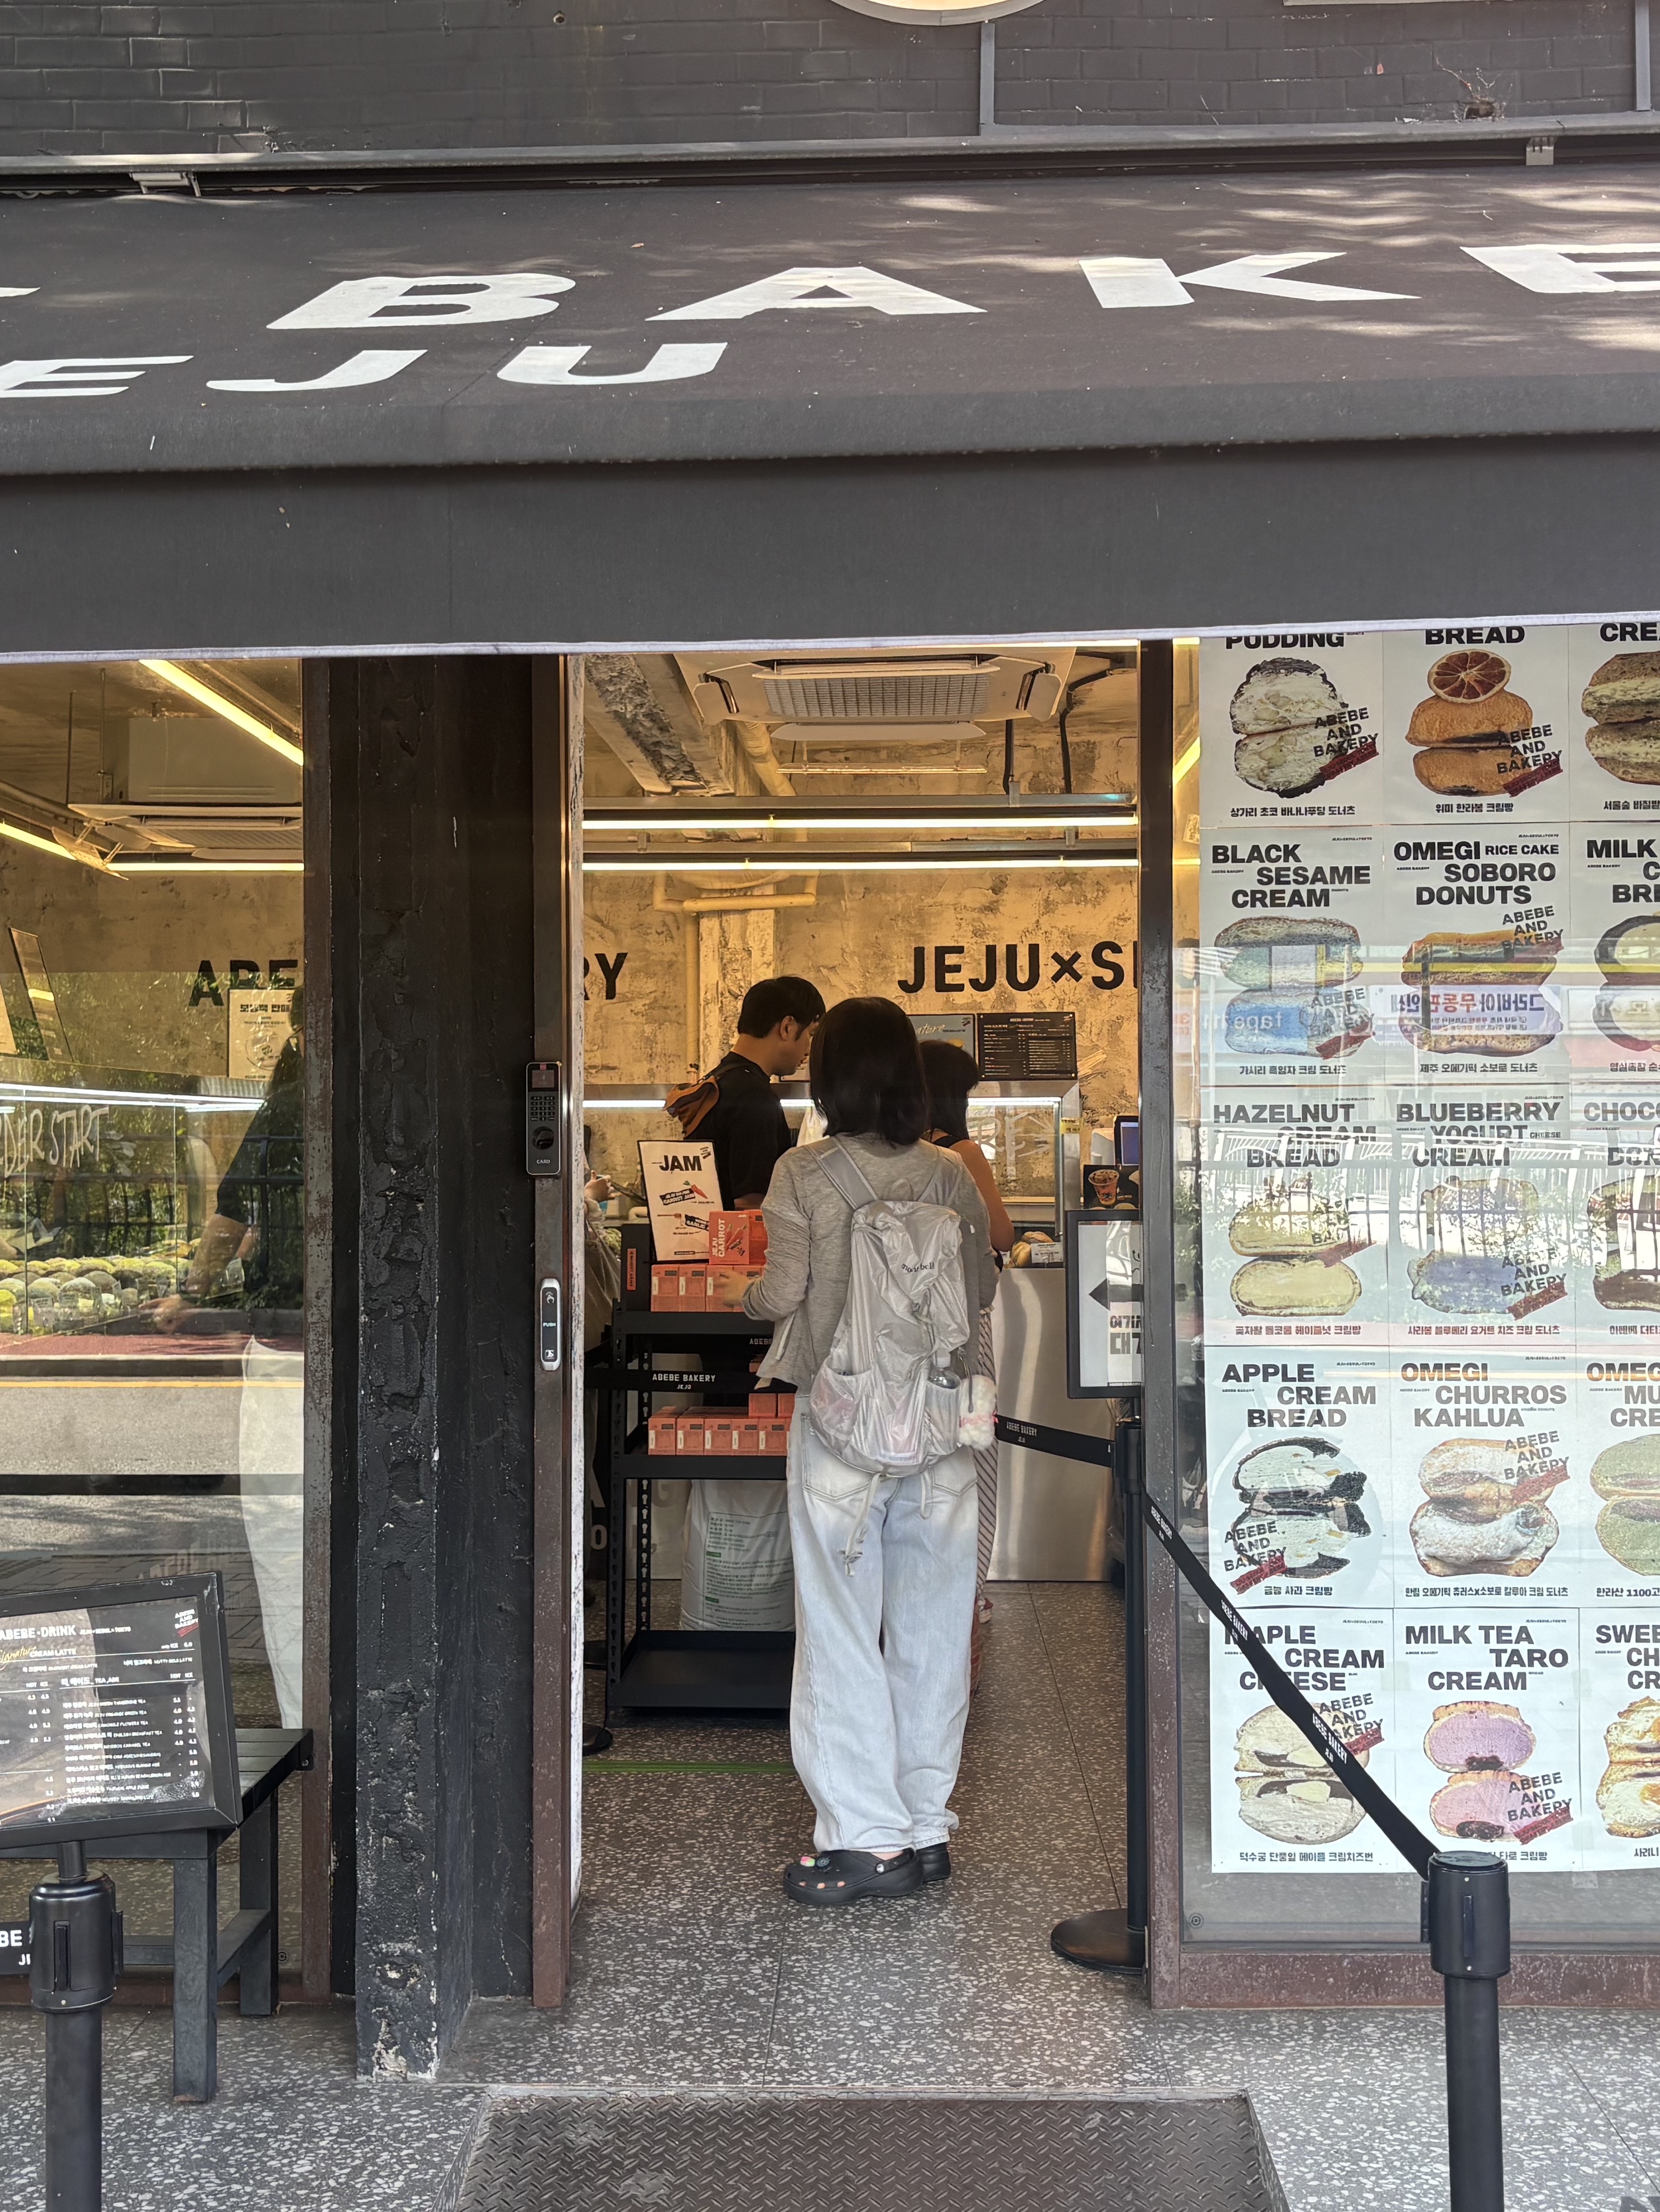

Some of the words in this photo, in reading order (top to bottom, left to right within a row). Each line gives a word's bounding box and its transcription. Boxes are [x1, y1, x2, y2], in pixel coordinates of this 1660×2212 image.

[1226, 633, 1345, 650] PUDDING
[1425, 626, 1525, 645] BREAD
[1600, 623, 1660, 642] CRE
[1314, 707, 1370, 729] ABEBE
[1326, 723, 1363, 740] AND
[1313, 733, 1379, 757] BAKERY
[1511, 740, 1546, 757] AND
[1496, 750, 1563, 774] BAKERY
[1230, 807, 1258, 817] 상가리
[1260, 807, 1278, 817] 초코
[1281, 806, 1326, 816] 바나나푸딩
[1328, 805, 1356, 816] 도너츠
[1435, 804, 1453, 813] 위미
[1456, 803, 1483, 813] 한라봉
[1486, 802, 1514, 813] 크림빵
[1603, 800, 1631, 811] 서울숲
[1212, 844, 1302, 863] BLACK
[1393, 841, 1481, 861] OMEGI
[1485, 845, 1518, 856] RICE
[1521, 844, 1559, 855] CAKE
[1587, 839, 1658, 858] MILK
[1257, 865, 1371, 886] SESAME
[1444, 862, 1556, 882] SOBORO
[1231, 889, 1330, 908] CREAM
[1416, 885, 1532, 905] DONUTS
[1502, 905, 1555, 925] ABEBE
[1514, 920, 1548, 937] AND
[1239, 1065, 1265, 1075] 가시리
[1269, 1066, 1296, 1075] 흑임자
[1298, 1065, 1317, 1075] 크림
[1420, 1064, 1438, 1073] 제주
[1442, 1064, 1477, 1073] 오메기떡
[1480, 1063, 1508, 1073] 소보로
[1510, 1063, 1538, 1073] 도너츠
[1214, 1104, 1355, 1124] HAZELNUT
[1397, 1102, 1561, 1122] BLUEBERRY
[50, 1104, 109, 1169] START
[1430, 1125, 1528, 1145] YOGURT
[1529, 1131, 1561, 1139] CHEESE
[659, 1155, 702, 1172] JAM
[1247, 1148, 1340, 1168] BREAD
[1413, 1147, 1511, 1167] CREAM
[1514, 1263, 1550, 1281] AND
[1501, 1273, 1568, 1297] BAKERY
[1334, 1325, 1361, 1335] 크림빵
[1470, 1325, 1495, 1335] 요거트
[1497, 1325, 1514, 1335] 치즈
[1516, 1325, 1533, 1335] 크림
[1535, 1325, 1560, 1335] 도너츠
[652, 1373, 680, 1382] ABEBE
[682, 1373, 716, 1383] BAKERY
[1222, 1363, 1315, 1383] APPLE
[1401, 1363, 1489, 1382] OMEGI
[1277, 1386, 1376, 1405] CREAM
[1435, 1385, 1568, 1404] CHURROS
[1247, 1409, 1347, 1428] BREAD
[1414, 1408, 1525, 1427] KAHLUA
[1504, 1431, 1560, 1452] ABEBE
[1517, 1446, 1553, 1463] AND
[1504, 1457, 1570, 1480] BAKERY
[1224, 1521, 1277, 1544] ABEBE
[1236, 1537, 1271, 1555] AND
[1224, 1547, 1287, 1572] BAKERY
[1285, 1586, 1303, 1595] 사과
[1305, 1586, 1333, 1596] 크림빵
[1405, 1587, 1420, 1598] 한림
[1529, 1586, 1544, 1597] 크림
[1546, 1586, 1569, 1597] 도너츠
[1596, 1587, 1624, 1598] 한라산
[1405, 1625, 1473, 1644] MILK
[1478, 1625, 1534, 1644] TEA
[1285, 1648, 1385, 1669] CREAM
[1490, 1649, 1569, 1668] TARO
[1428, 1671, 1527, 1691] CREAM
[1319, 1693, 1374, 1715] ABEBE
[1331, 1709, 1367, 1727] AND
[1508, 1772, 1563, 1794] ABEBE
[1520, 1788, 1556, 1806] AND
[1507, 1797, 1573, 1822] BAKERY
[1240, 1852, 1267, 1862] 덕수궁
[1328, 1852, 1374, 1862] 크림치즈번
[1520, 1851, 1548, 1861] 크림빵
